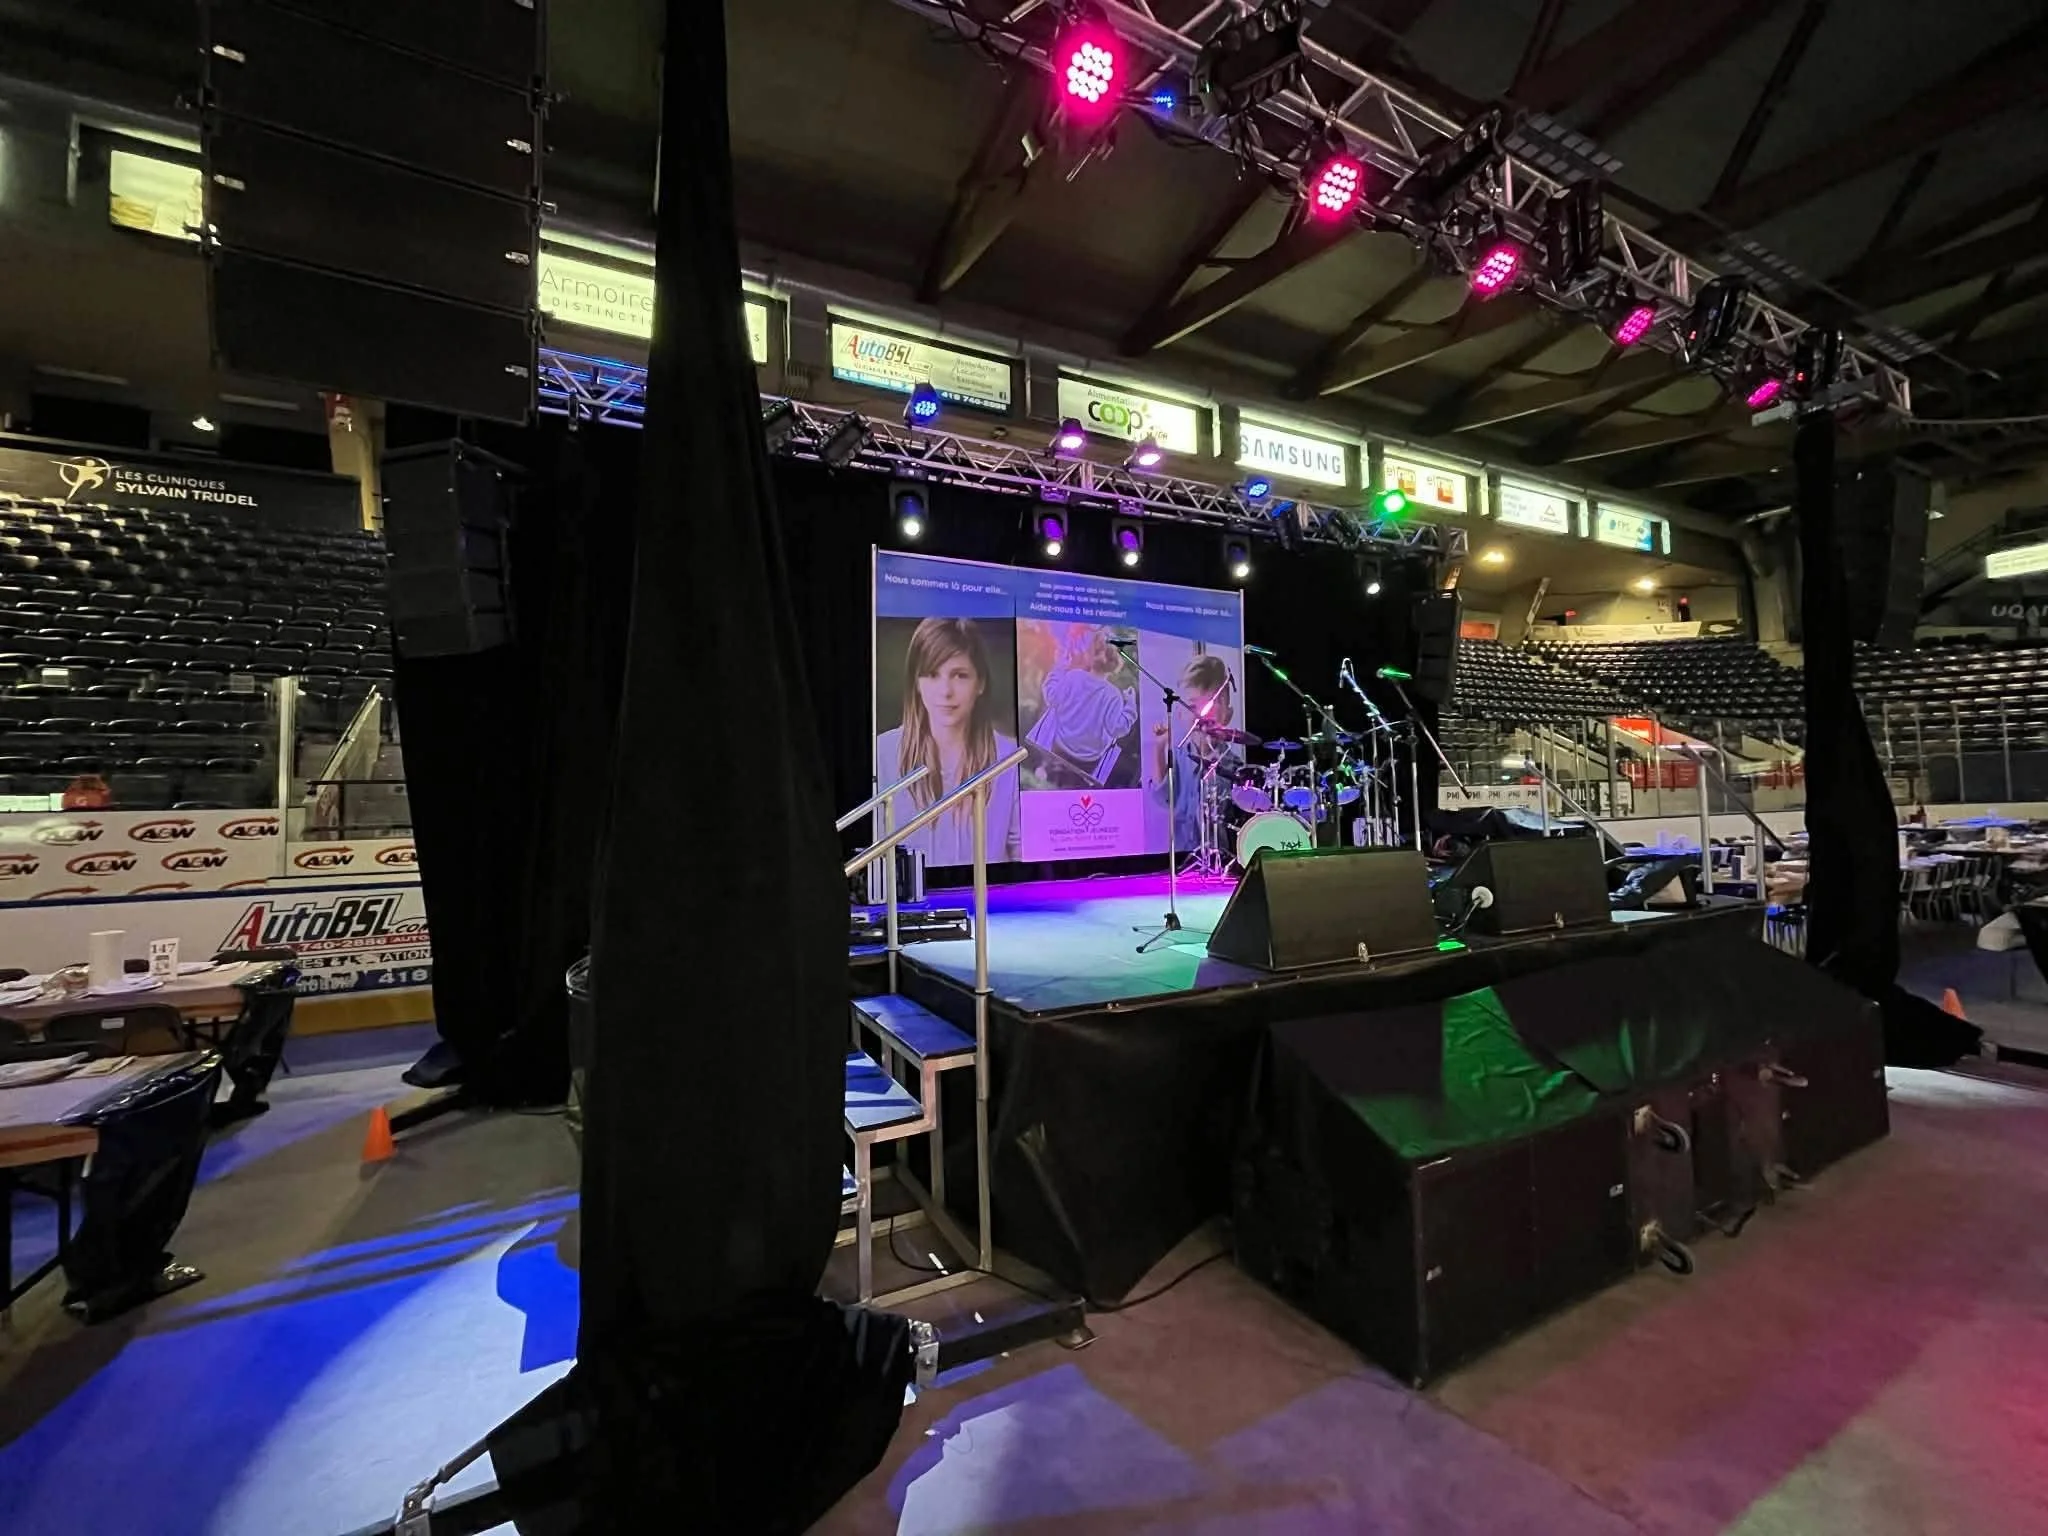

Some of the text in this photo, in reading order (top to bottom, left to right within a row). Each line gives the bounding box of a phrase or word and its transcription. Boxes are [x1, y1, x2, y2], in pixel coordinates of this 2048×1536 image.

[1239, 435, 1341, 474] SAMSUNG
[116, 470, 226, 491] LES CLINIQUES
[115, 481, 259, 507] SYLVAIN TRUDEL
[884, 573, 909, 585] Nous
[910, 580, 949, 589] sommes
[951, 581, 960, 590] là
[962, 583, 983, 593] pour
[1030, 602, 1073, 613] Aidez-nous
[1082, 608, 1094, 616] les
[140, 827, 196, 840] A&W
[228, 823, 279, 837] A&W
[78, 859, 138, 874] A&W
[172, 855, 228, 869] A&W
[304, 854, 354, 867] A&W
[301, 938, 386, 951] 740-2886
[379, 968, 429, 984] 418
